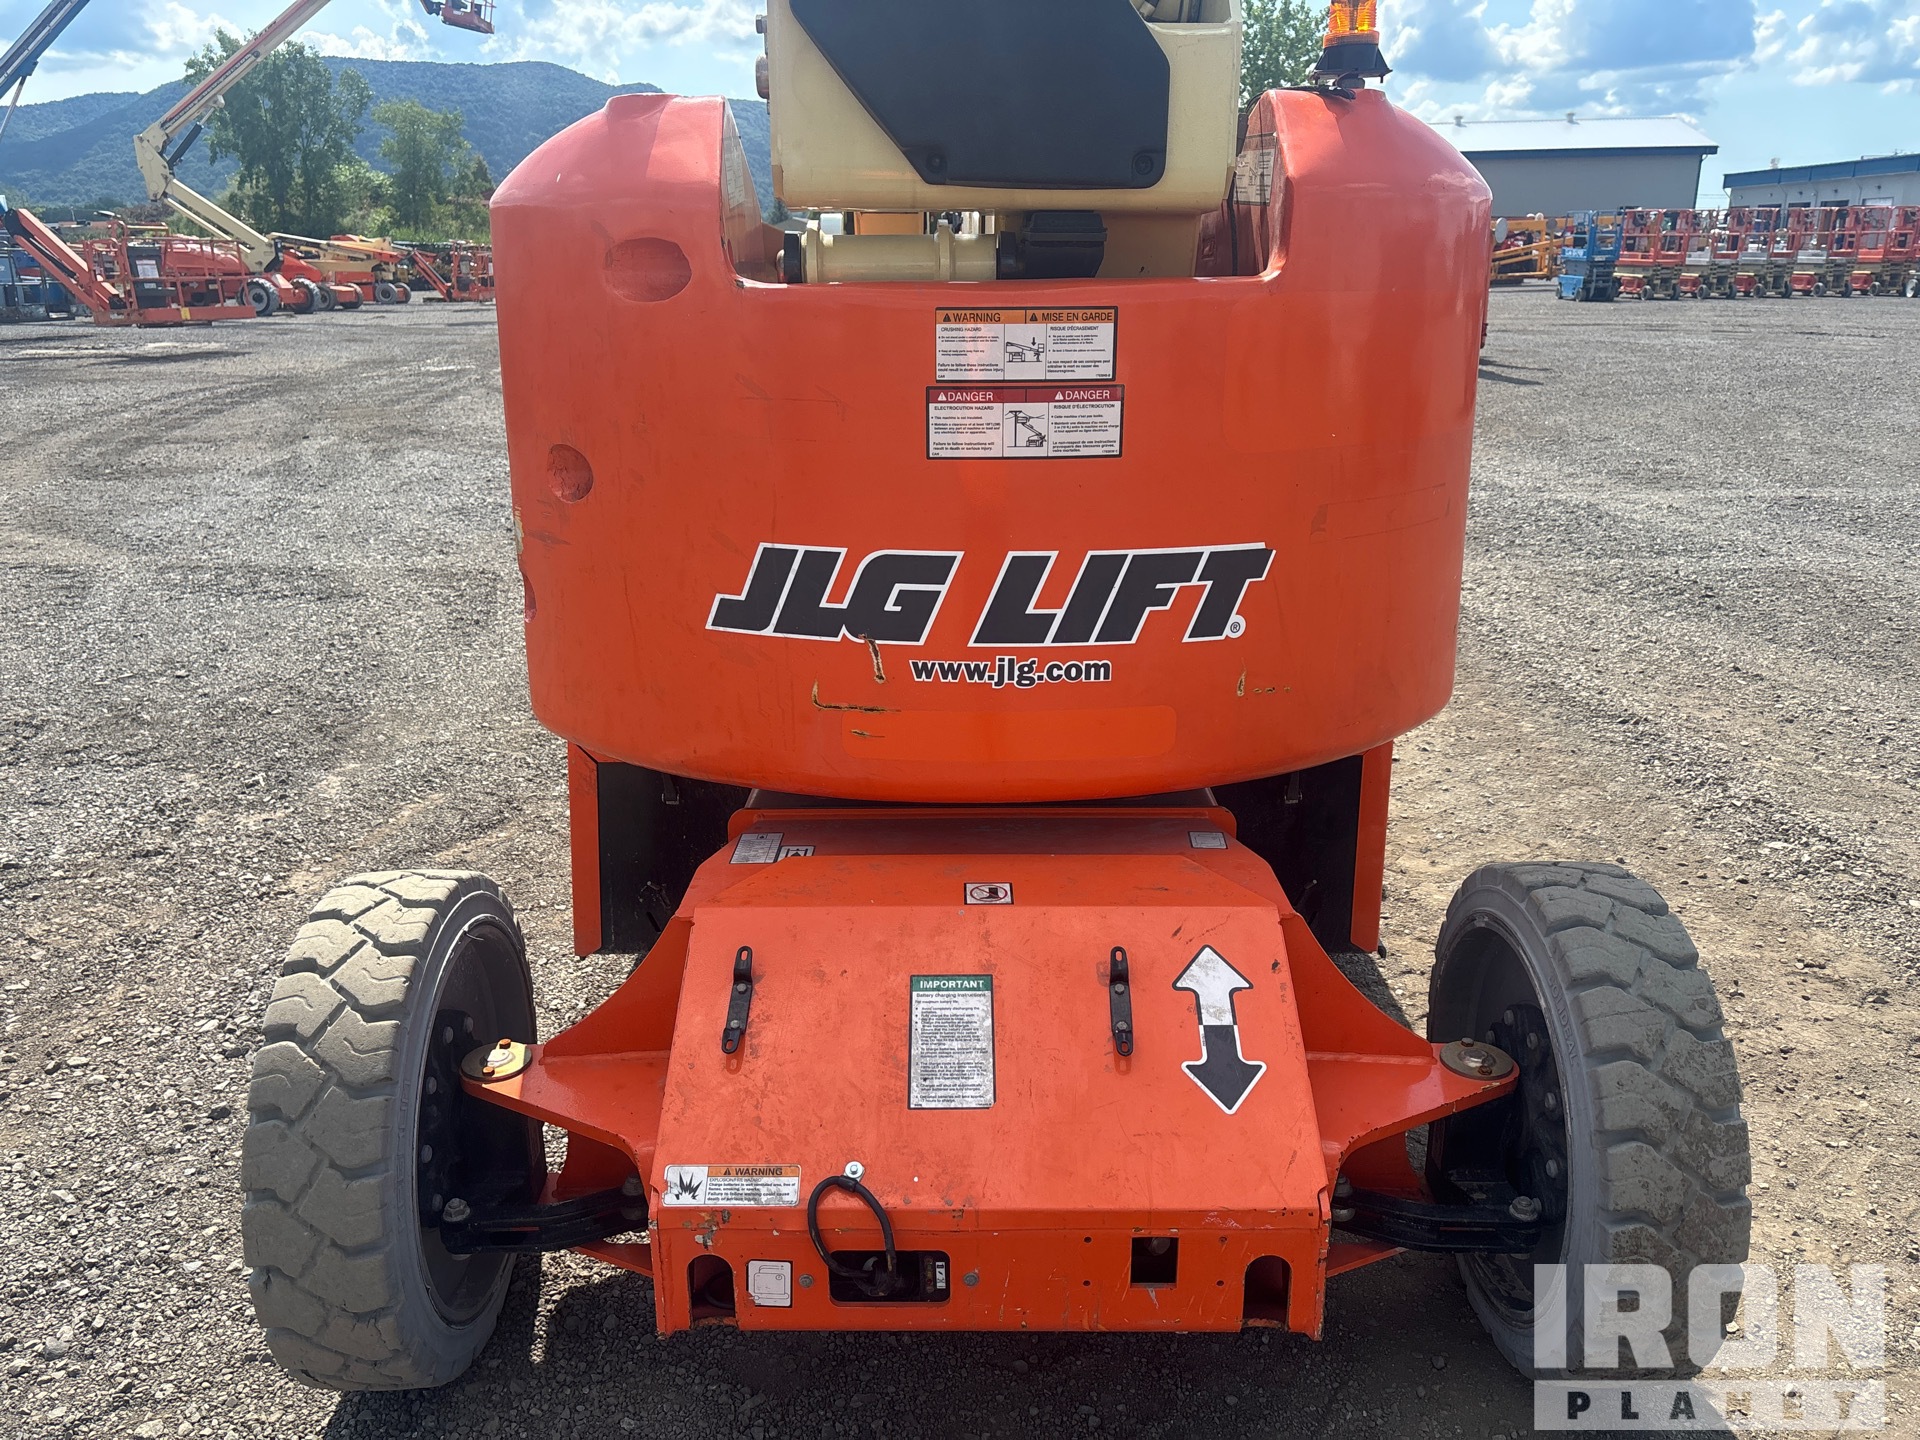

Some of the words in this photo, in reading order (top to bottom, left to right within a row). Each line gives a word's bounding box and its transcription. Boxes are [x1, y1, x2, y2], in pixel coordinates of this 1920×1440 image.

[953, 313, 1000, 322] WARNING
[1042, 313, 1063, 321] MISE
[1066, 313, 1078, 321] EN
[1082, 313, 1112, 321] GARDE
[948, 392, 993, 401] DANGER
[1066, 390, 1110, 399] DANGER
[706, 542, 964, 645] JLG
[969, 543, 1275, 646] LIFT
[910, 656, 1111, 688] www.jlg.com
[1547, 976, 1578, 1065] SOLIDEAL
